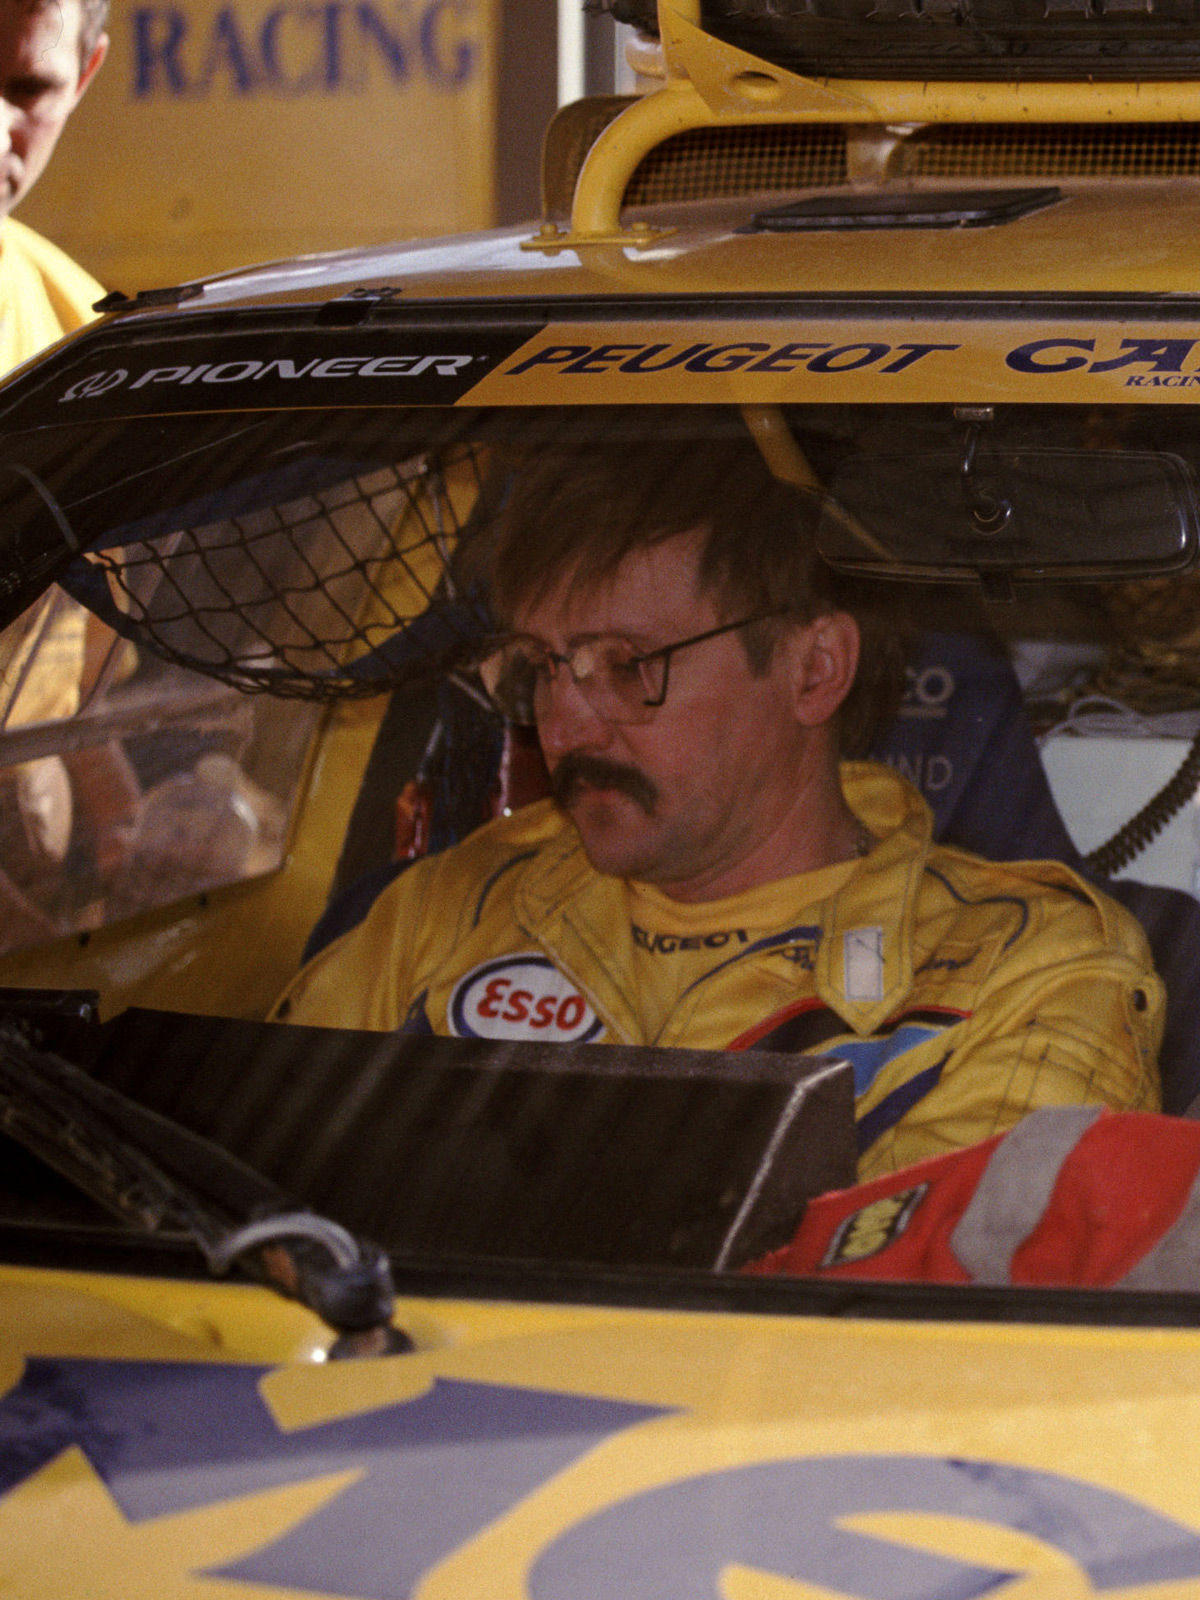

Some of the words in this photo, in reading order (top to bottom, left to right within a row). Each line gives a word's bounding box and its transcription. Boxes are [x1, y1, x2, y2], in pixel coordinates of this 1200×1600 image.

[128, 1, 478, 98] RACING
[128, 354, 474, 390] PIONEER
[503, 342, 964, 375] PEUGEOT
